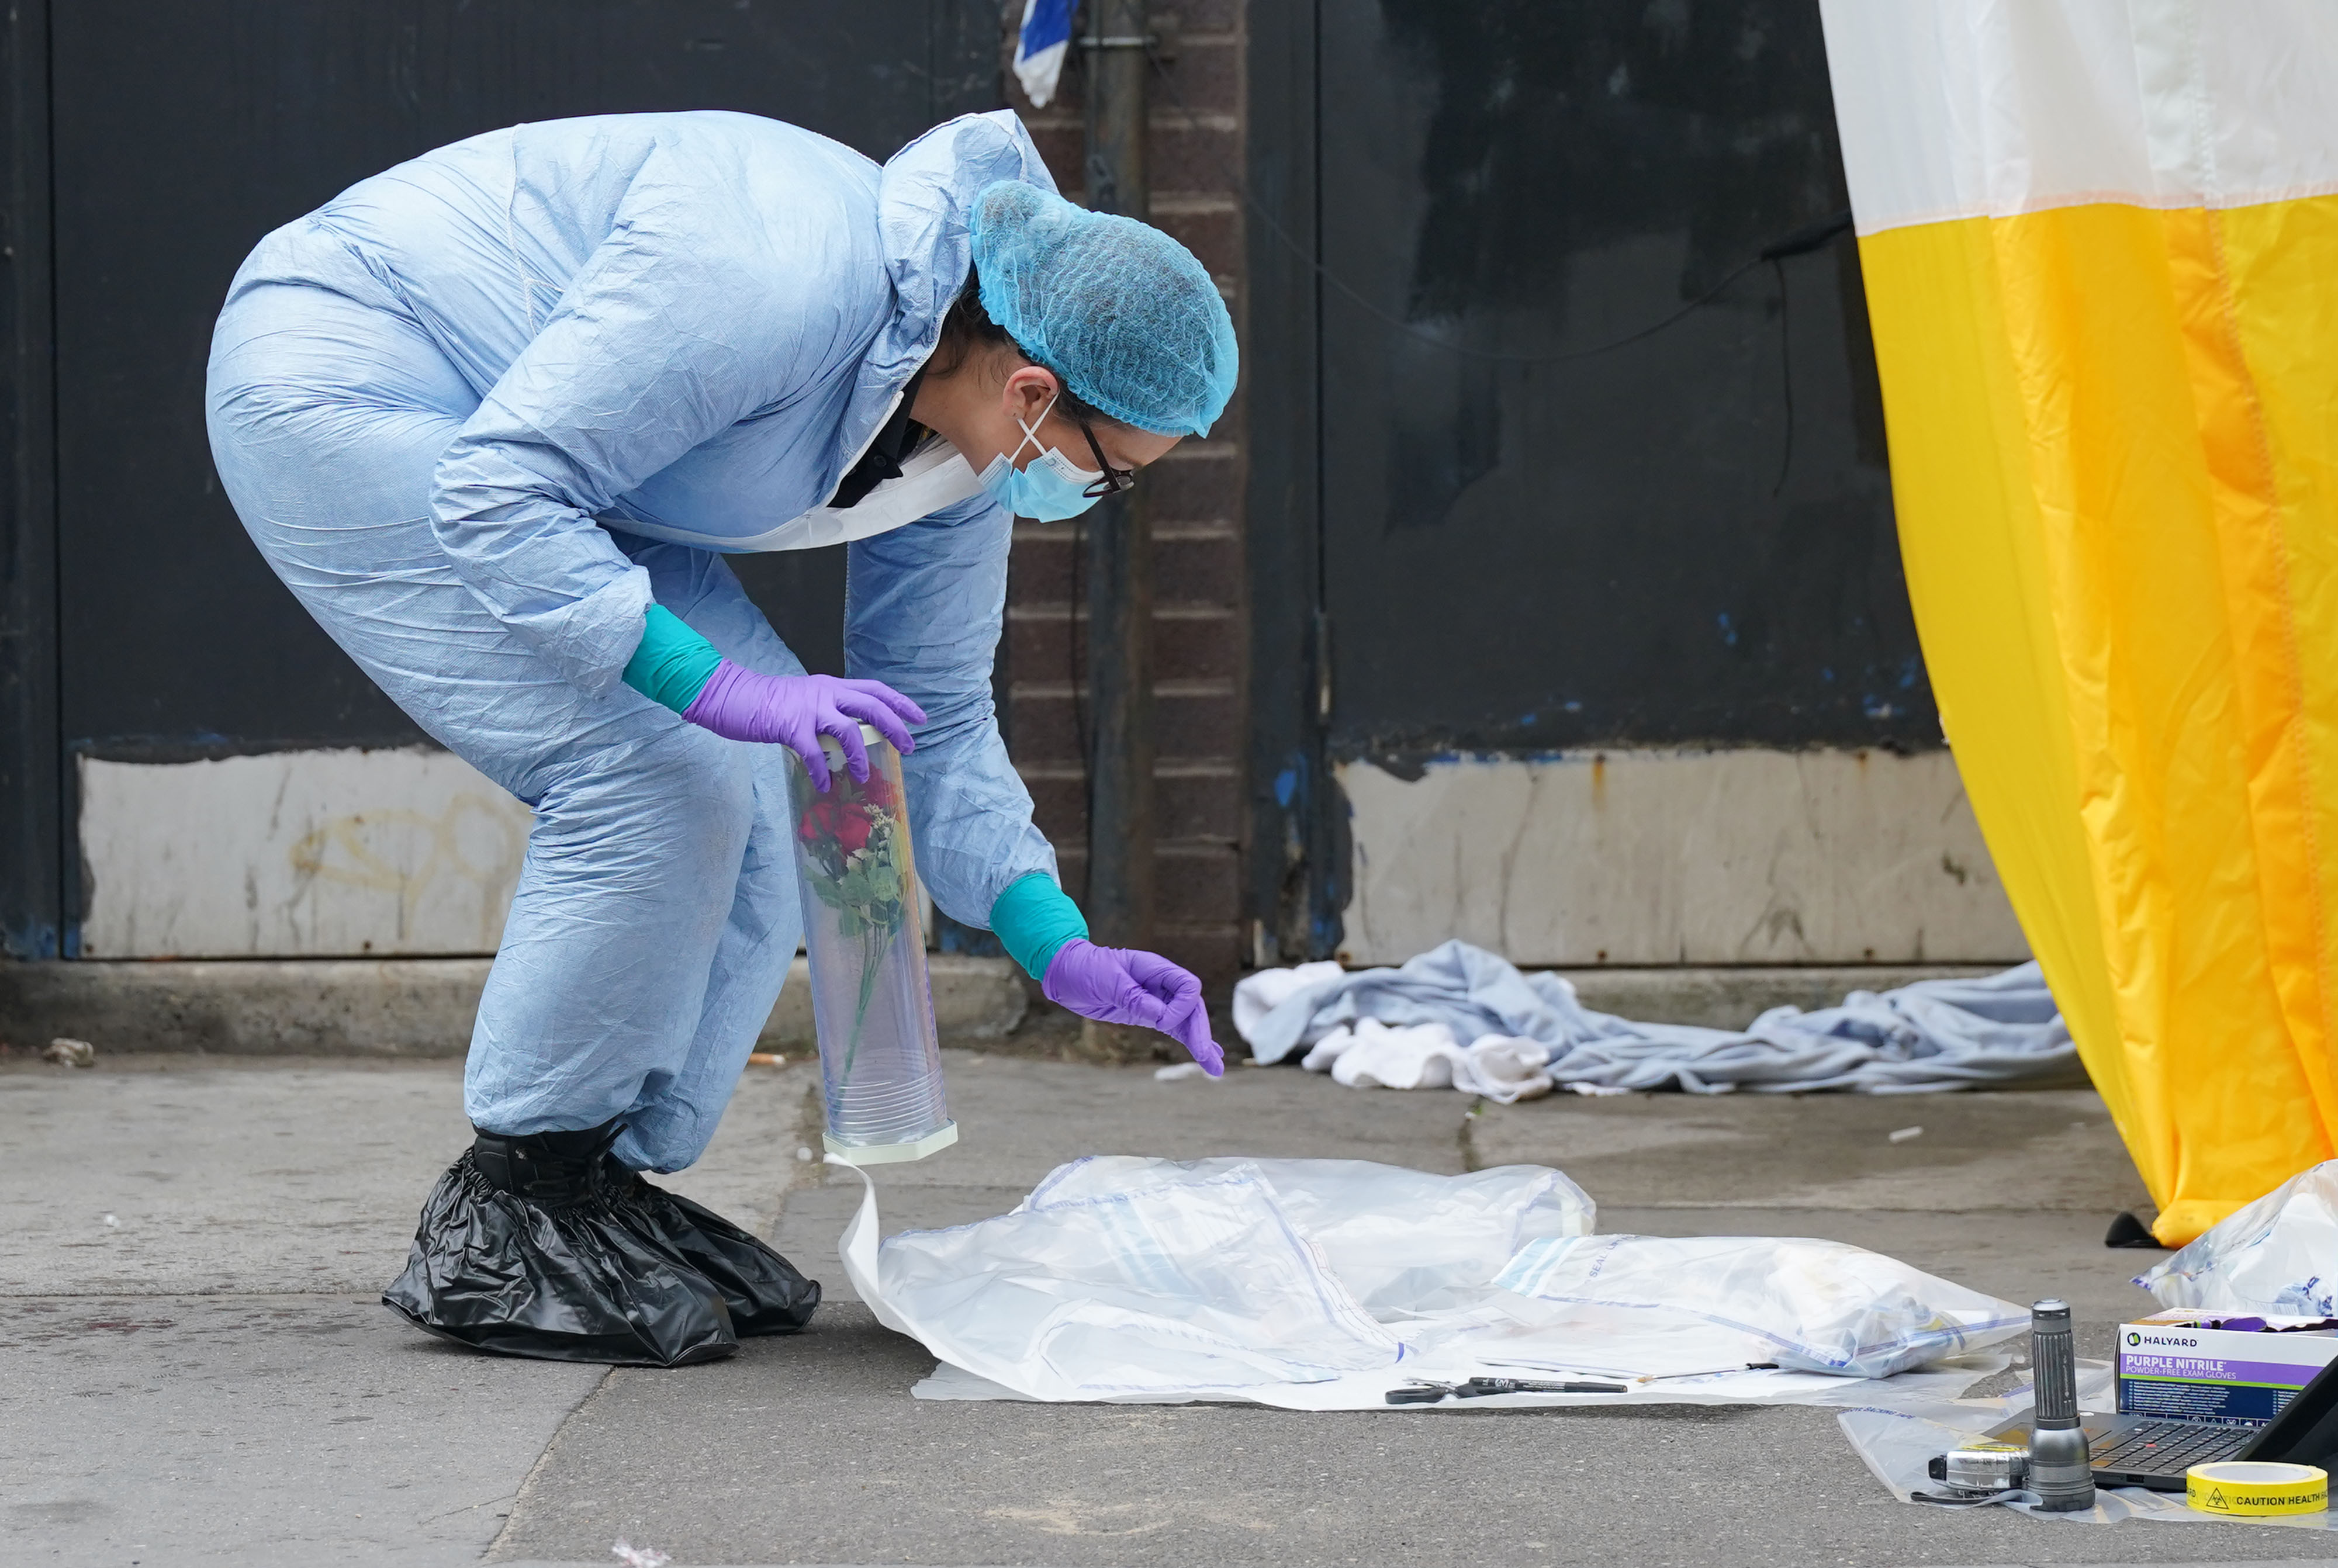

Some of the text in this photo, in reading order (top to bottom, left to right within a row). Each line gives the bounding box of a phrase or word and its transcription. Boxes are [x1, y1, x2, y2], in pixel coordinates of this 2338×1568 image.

[1589, 1254, 1609, 1278] SEAL
[2144, 1336, 2197, 1347] HALYARD
[2126, 1355, 2225, 1372] PURPLE NITRILE
[2125, 1365, 2237, 1380] POWDER-FREE EXAM GLOVES
[2236, 1496, 2285, 1506] CAUTION
[2288, 1493, 2320, 1505] HEALTH
